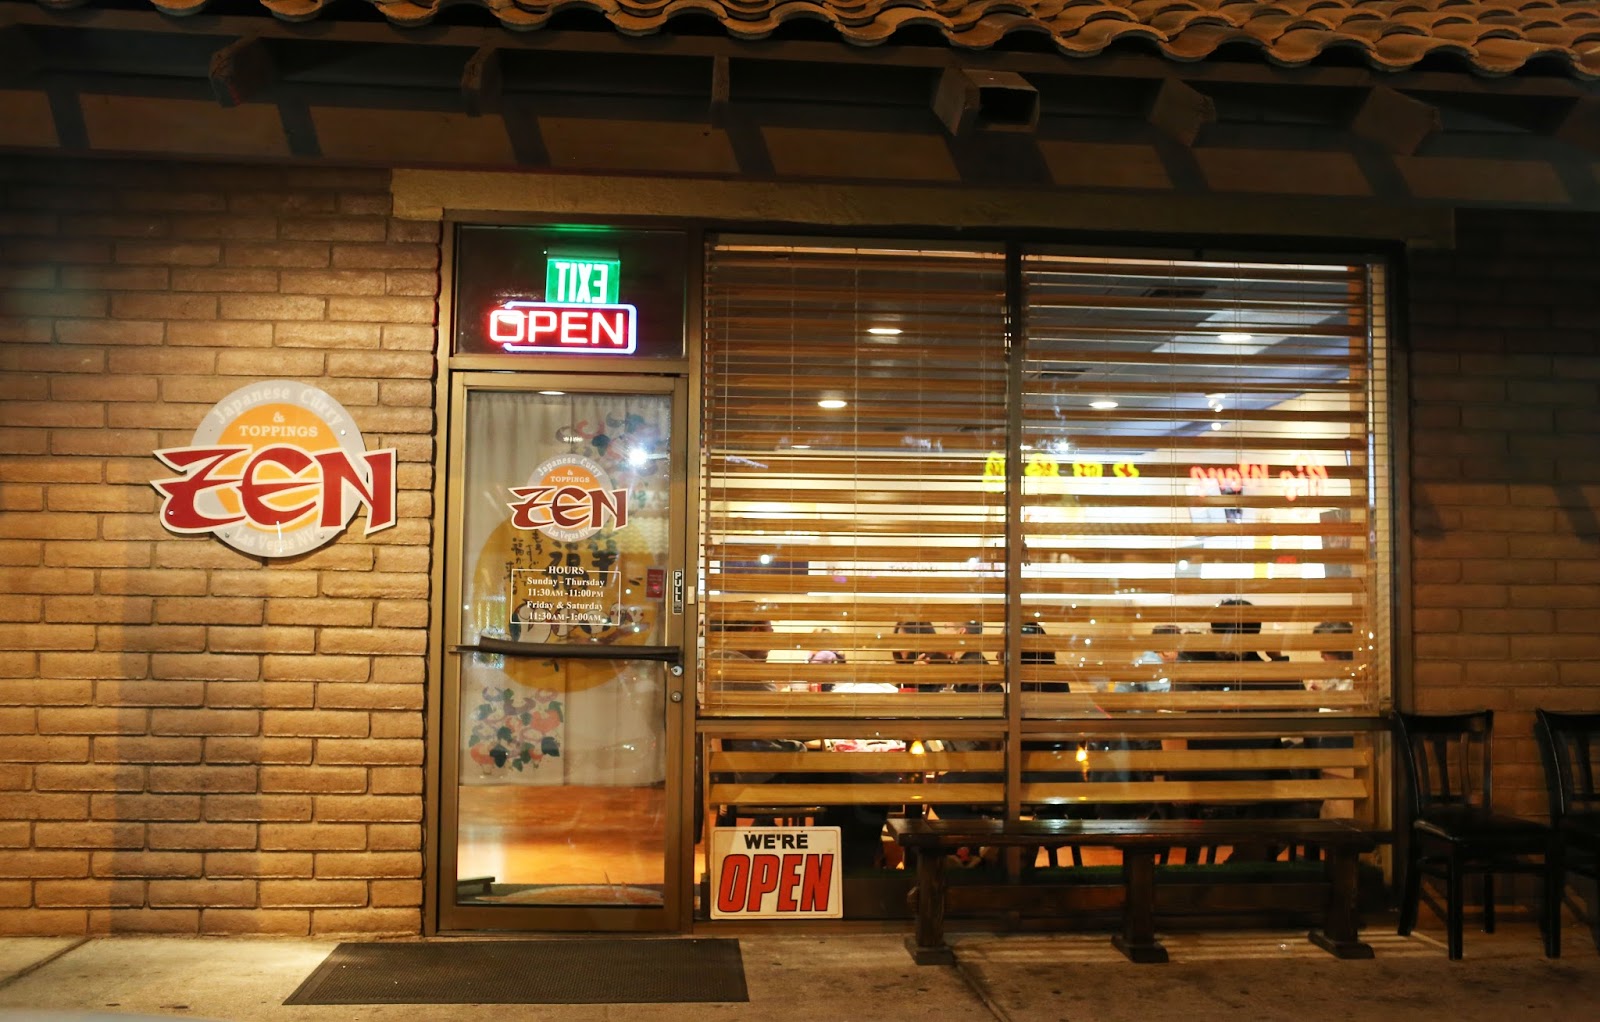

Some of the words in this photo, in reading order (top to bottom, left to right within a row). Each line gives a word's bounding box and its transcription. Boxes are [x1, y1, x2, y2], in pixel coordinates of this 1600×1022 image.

[489, 309, 624, 345] OPEN
[213, 385, 291, 425] Japanese
[300, 388, 345, 426] Curry
[272, 411, 286, 424] &
[238, 425, 319, 438] TOPPINGS
[538, 457, 576, 476] Japanese
[580, 458, 603, 478] Curry
[548, 527, 560, 538] Las
[560, 530, 580, 542] Vegas
[548, 566, 585, 575] HOURS
[527, 578, 558, 587] Sunday
[565, 578, 605, 588] Thursday
[674, 571, 683, 602] PULL
[526, 600, 555, 610] Friday
[566, 601, 603, 612] Saturday
[744, 834, 809, 850] WE'RE
[717, 854, 834, 913] OPEN
